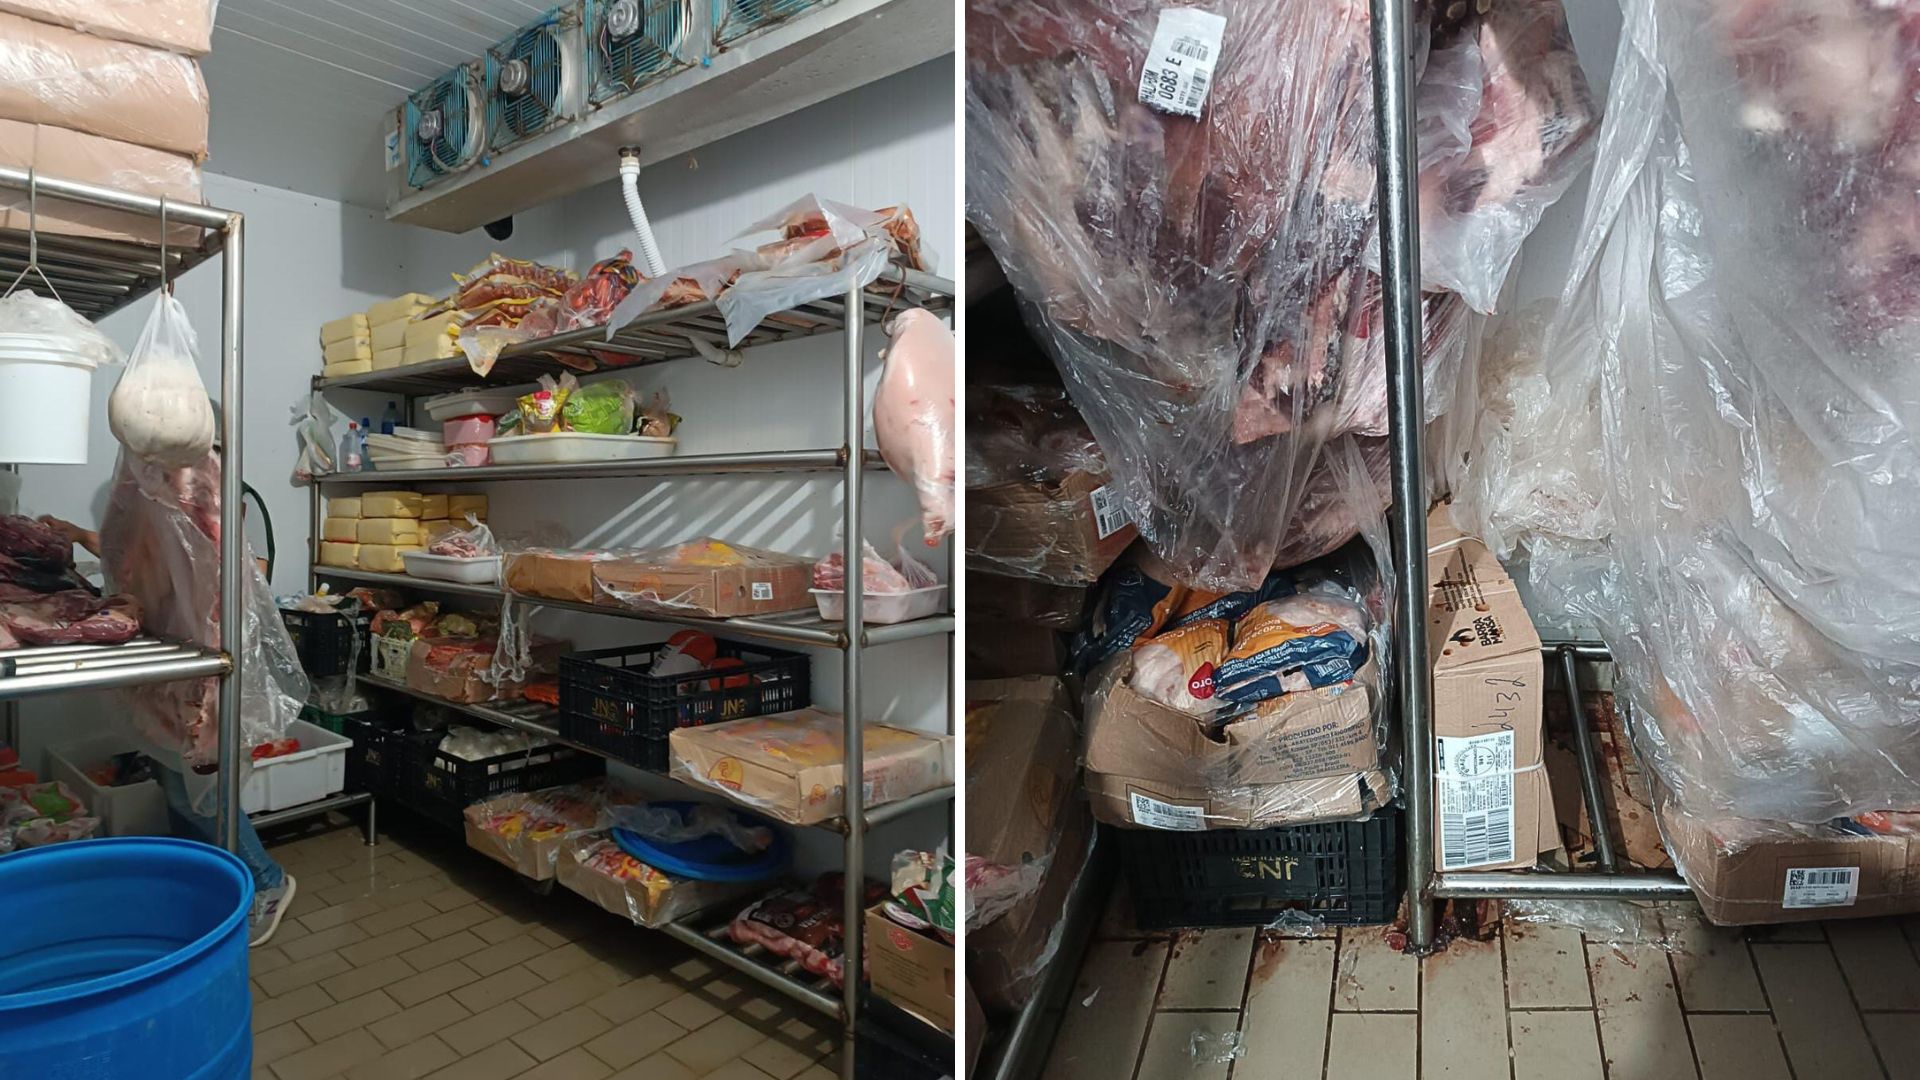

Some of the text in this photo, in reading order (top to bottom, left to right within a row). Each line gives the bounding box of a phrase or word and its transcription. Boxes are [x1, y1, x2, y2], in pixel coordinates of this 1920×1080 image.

[1158, 56, 1182, 100] 0683 E
[1473, 617, 1492, 647] BARRA
[1279, 727, 1320, 742] PRODUZIDO
